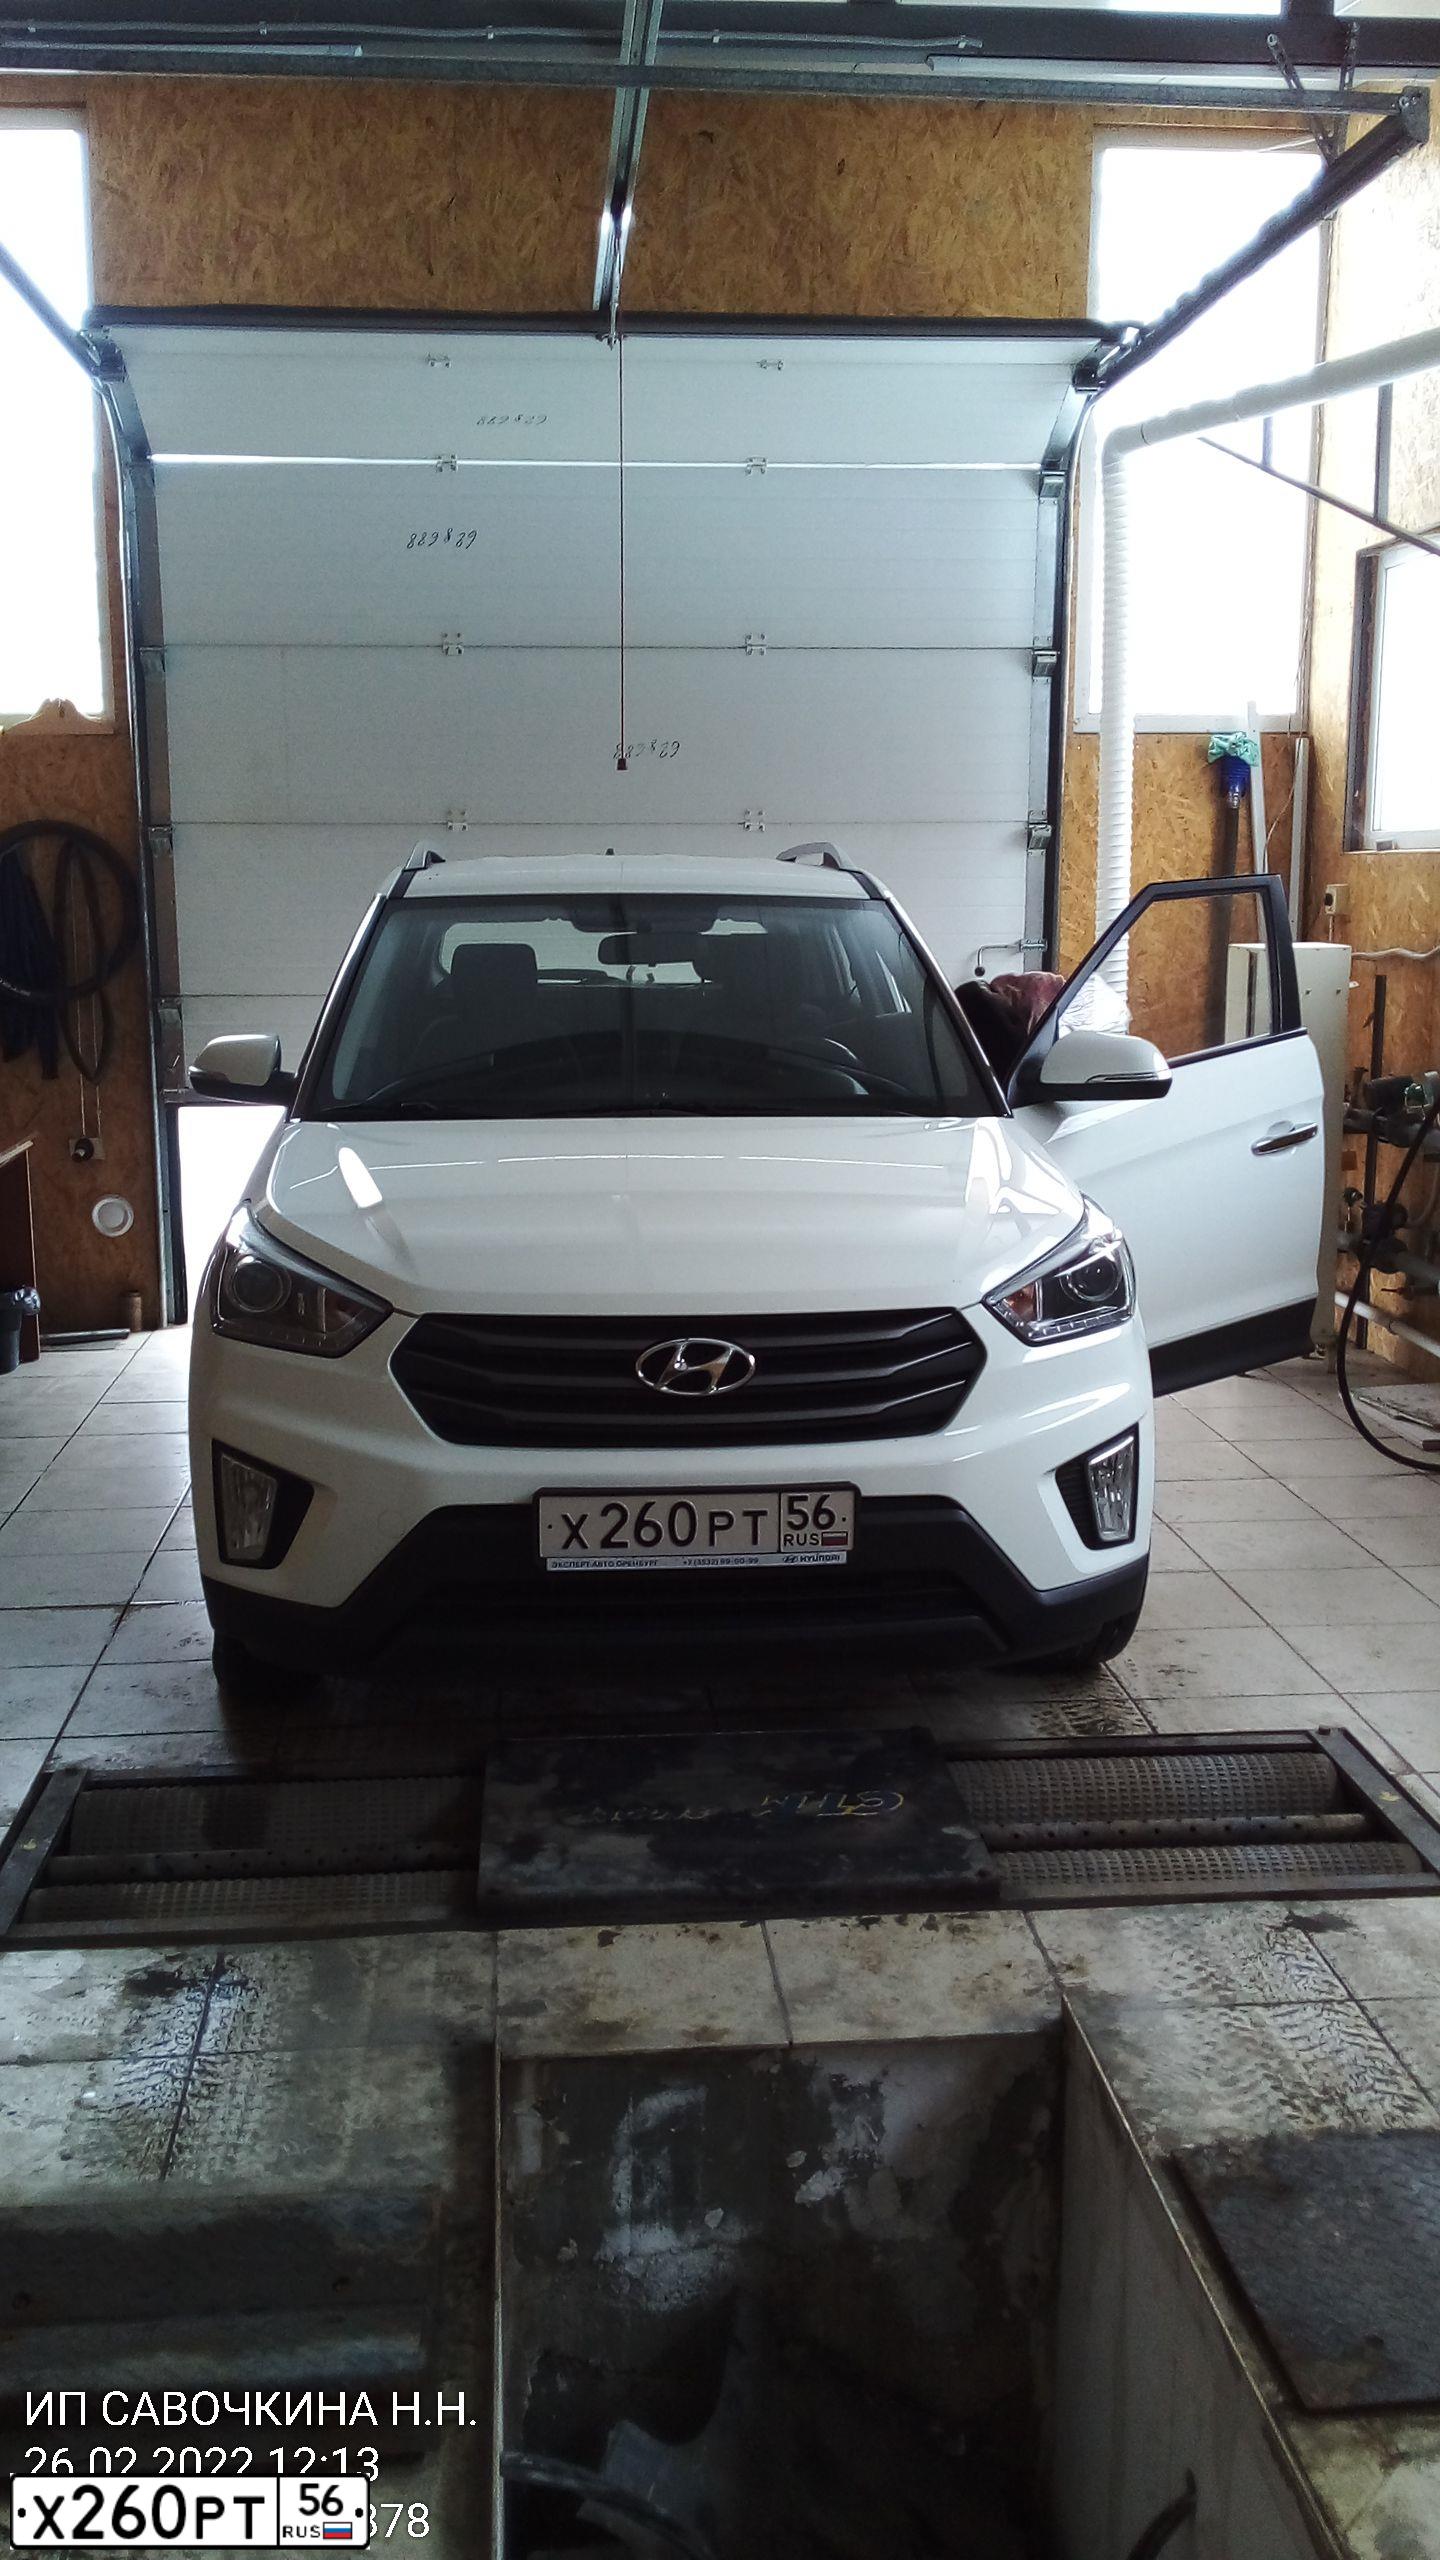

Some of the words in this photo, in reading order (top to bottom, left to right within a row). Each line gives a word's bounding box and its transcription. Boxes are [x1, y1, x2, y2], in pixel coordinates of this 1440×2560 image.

[787, 1494, 837, 1531] 56
[783, 1532, 820, 1547] RUS
[800, 1553, 840, 1562] HYUNDAI
